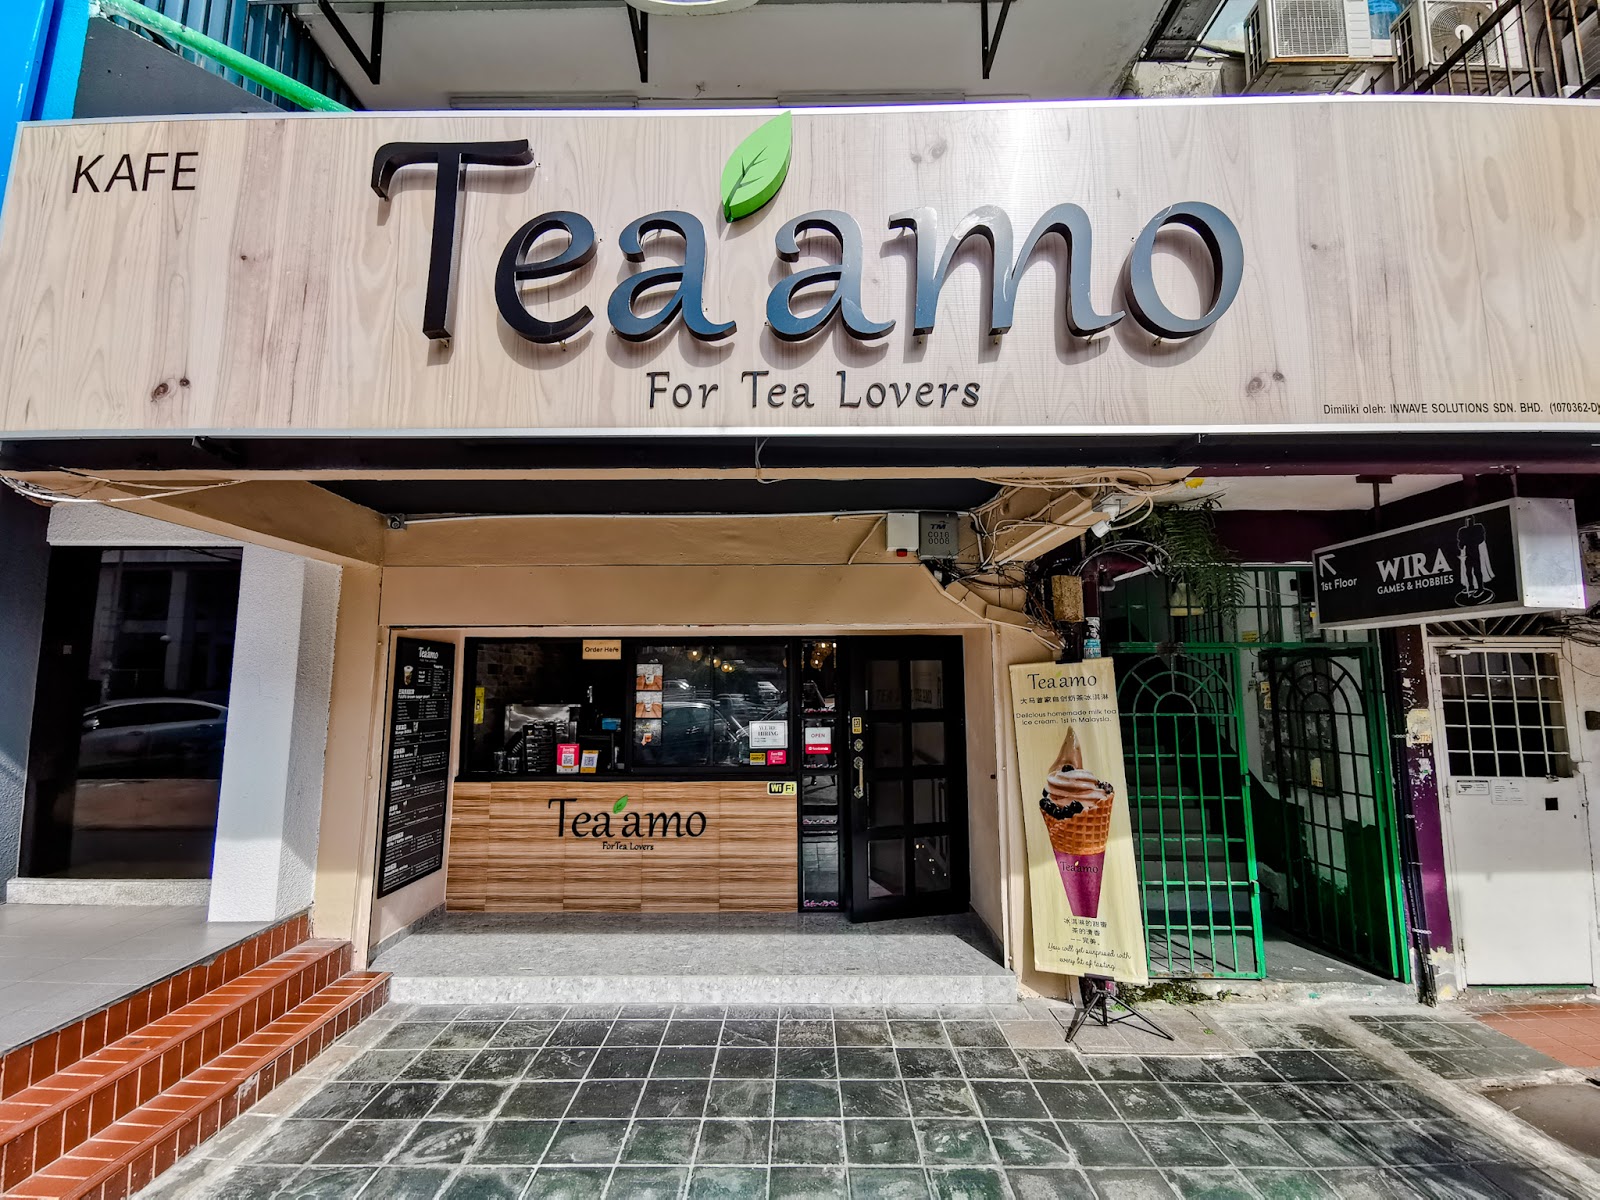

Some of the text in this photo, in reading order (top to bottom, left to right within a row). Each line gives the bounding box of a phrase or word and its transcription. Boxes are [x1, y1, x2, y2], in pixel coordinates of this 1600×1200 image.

[72, 152, 198, 193] KAFE
[646, 370, 981, 409] For Tea Lovers
[1323, 404, 1359, 415] Dimiliki
[1363, 404, 1386, 414] oleh:
[1390, 403, 1428, 414] INWAVE
[1431, 403, 1489, 413] SOLUTIONS
[1493, 403, 1517, 413] SDN.
[1520, 403, 1543, 413] BHD.
[930, 522, 947, 530] TM
[1376, 548, 1453, 582] WIRA
[1321, 578, 1357, 591] 1st Floor
[1377, 575, 1454, 594] GAMES & HOBBIES
[602, 841, 654, 851] For Tea Lovers
